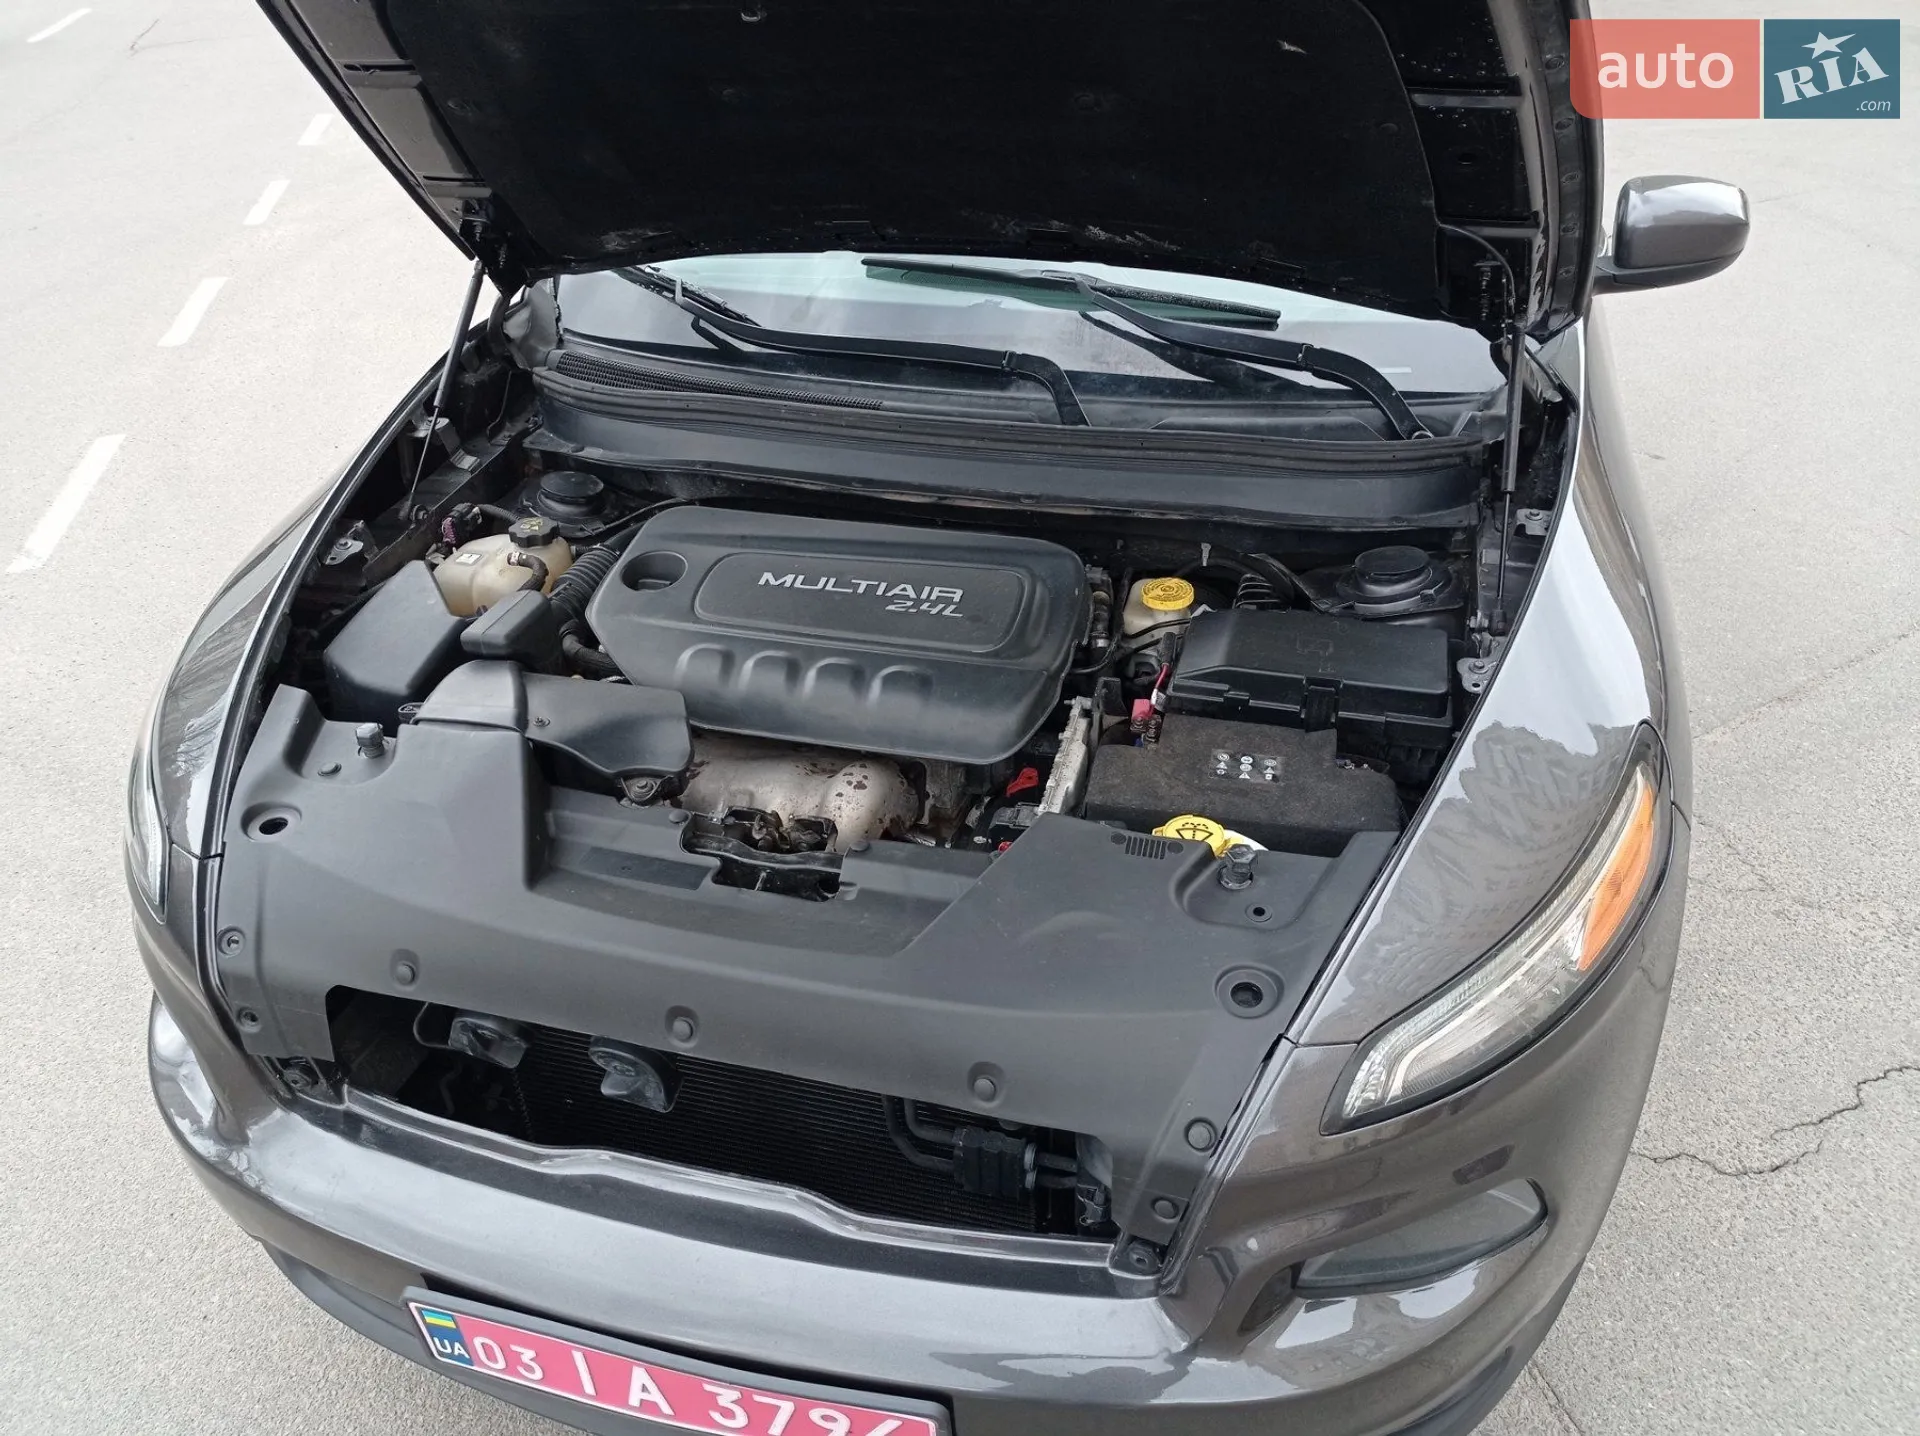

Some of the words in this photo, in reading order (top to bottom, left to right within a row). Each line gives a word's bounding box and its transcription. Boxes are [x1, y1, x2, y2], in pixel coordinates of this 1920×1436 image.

[758, 571, 964, 602] MULTIAIR
[885, 599, 964, 617] 2.4L
[433, 1336, 470, 1359] UA
[473, 1336, 545, 1381] 03
